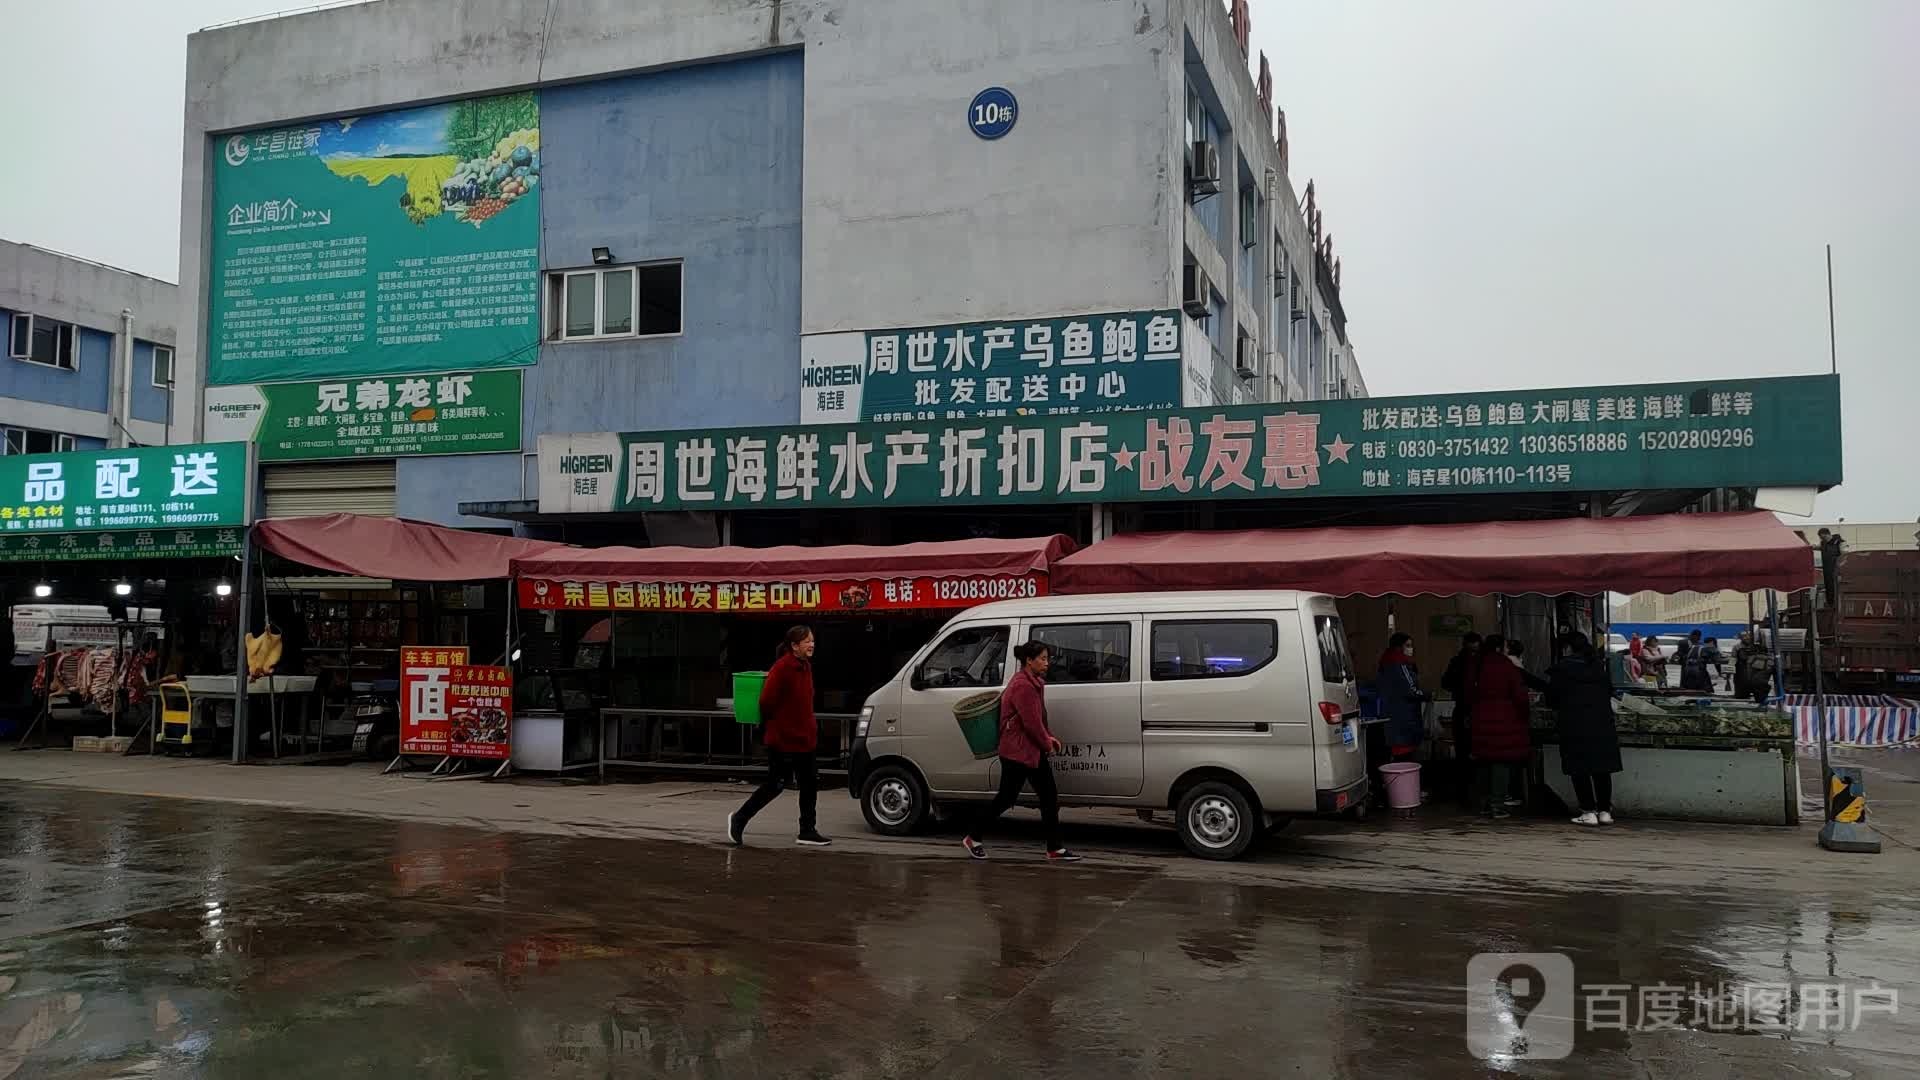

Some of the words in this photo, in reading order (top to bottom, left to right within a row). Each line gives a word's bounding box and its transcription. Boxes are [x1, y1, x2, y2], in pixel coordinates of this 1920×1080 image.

[975, 103, 1012, 125] 10栋
[228, 198, 298, 226] 企业简介
[868, 316, 1180, 376] 周世水产乌鱼鲍鱼
[316, 376, 473, 413] 兄弟龙虾
[817, 390, 845, 411] 海吉星
[915, 371, 1127, 405] 批发配送中心
[1488, 402, 1526, 426] 鲍鱼
[1531, 399, 1590, 424] 大闸蟹
[1596, 396, 1637, 422] 美蛙
[1643, 394, 1684, 420] 海鲜
[1690, 391, 1753, 418] 鲜等
[392, 422, 439, 435] 新鲜美味
[1519, 432, 1628, 455] 13036518886
[1638, 428, 1754, 450] 15202809296
[626, 422, 1108, 505] 周世海鲜水产折扣店
[1140, 411, 1320, 493] 战友惠
[24, 451, 218, 503] 品配送
[573, 477, 598, 496] 海吉星
[0, 504, 64, 519] 各类食材
[563, 582, 821, 609] 荣昌卤鹅批发配送中心
[405, 651, 465, 666] 车车面馆
[406, 667, 450, 726] 面
[451, 684, 509, 697] 批发配送中心
